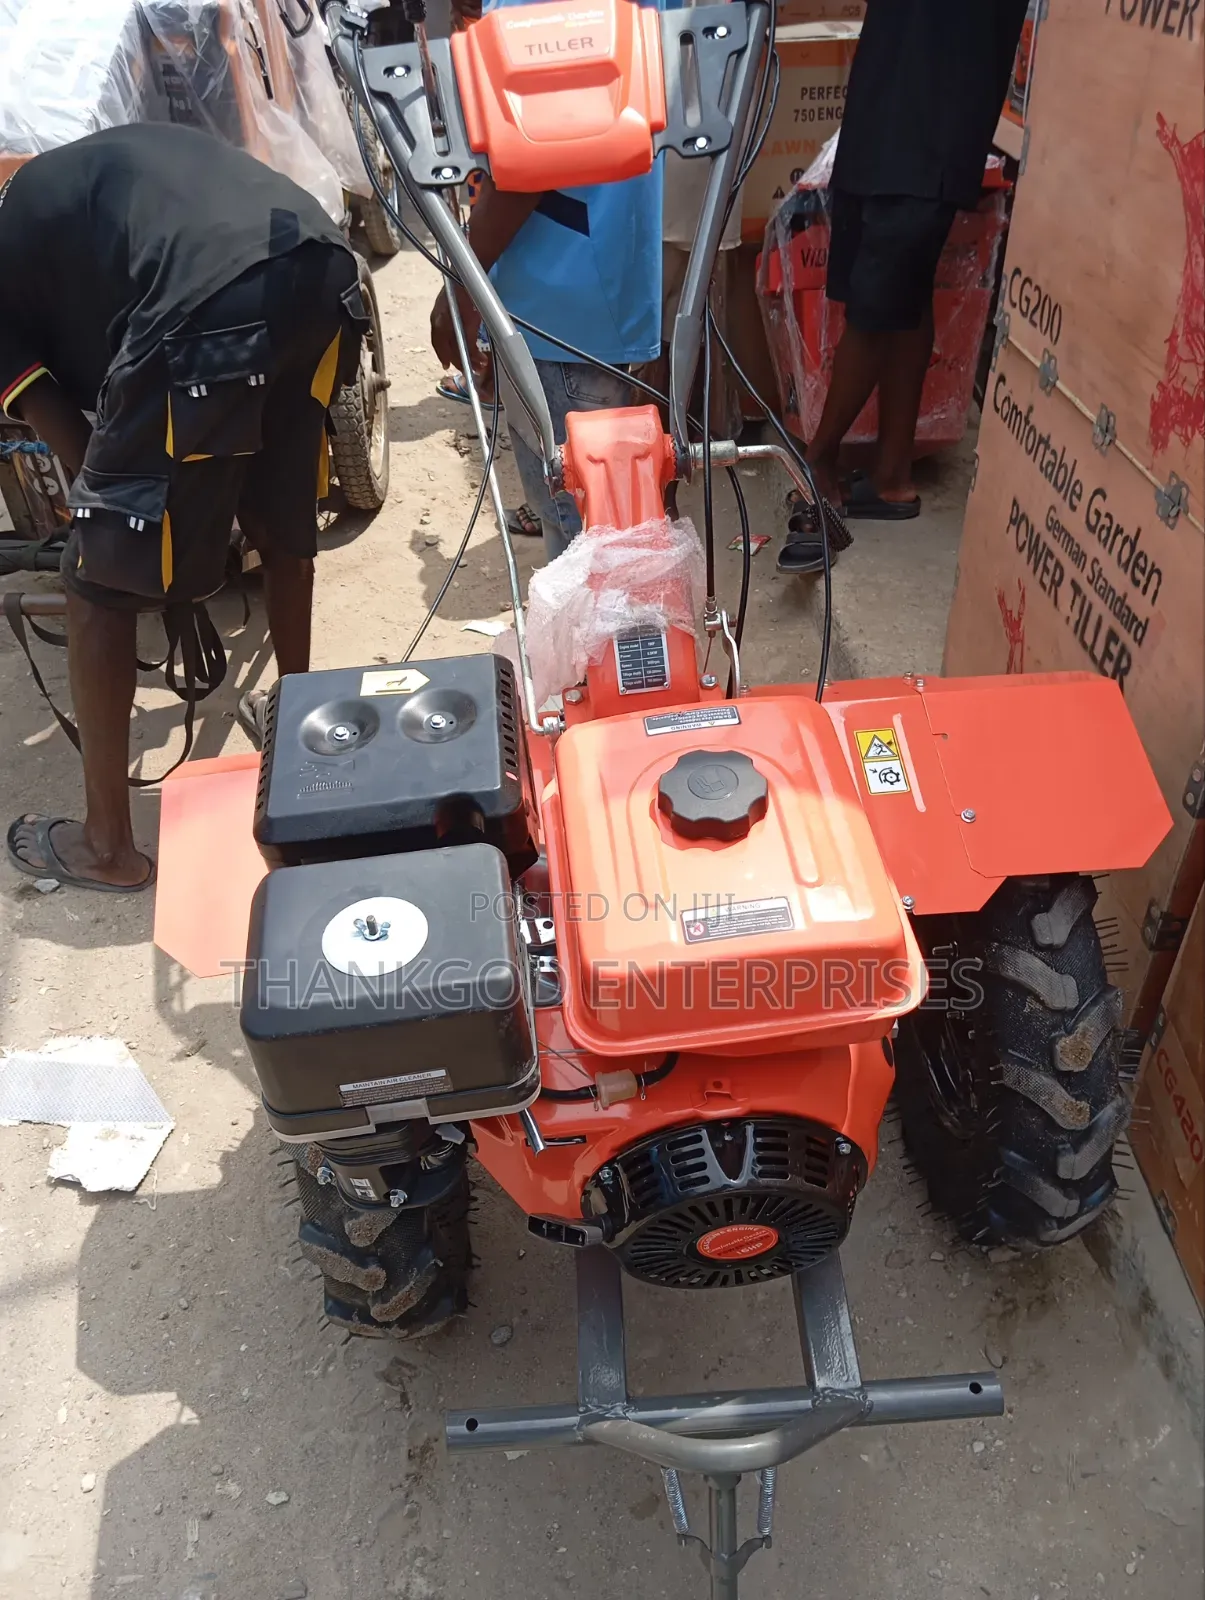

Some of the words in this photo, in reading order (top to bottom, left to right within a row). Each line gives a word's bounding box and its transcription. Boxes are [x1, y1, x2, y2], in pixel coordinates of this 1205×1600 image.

[524, 36, 594, 57] TILLER
[793, 108, 815, 122] 750
[1008, 267, 1062, 346] CG200
[993, 373, 1084, 513] Comfortable
[1084, 487, 1163, 606] Garden
[1005, 496, 1065, 611] POWER
[1066, 577, 1133, 692] TILLER
[1045, 504, 1088, 573] German
[1086, 557, 1150, 648] Standard
[352, 1080, 386, 1089] MAINTAIN
[398, 1073, 432, 1082] CLEANER
[1156, 1048, 1203, 1163] CG420
